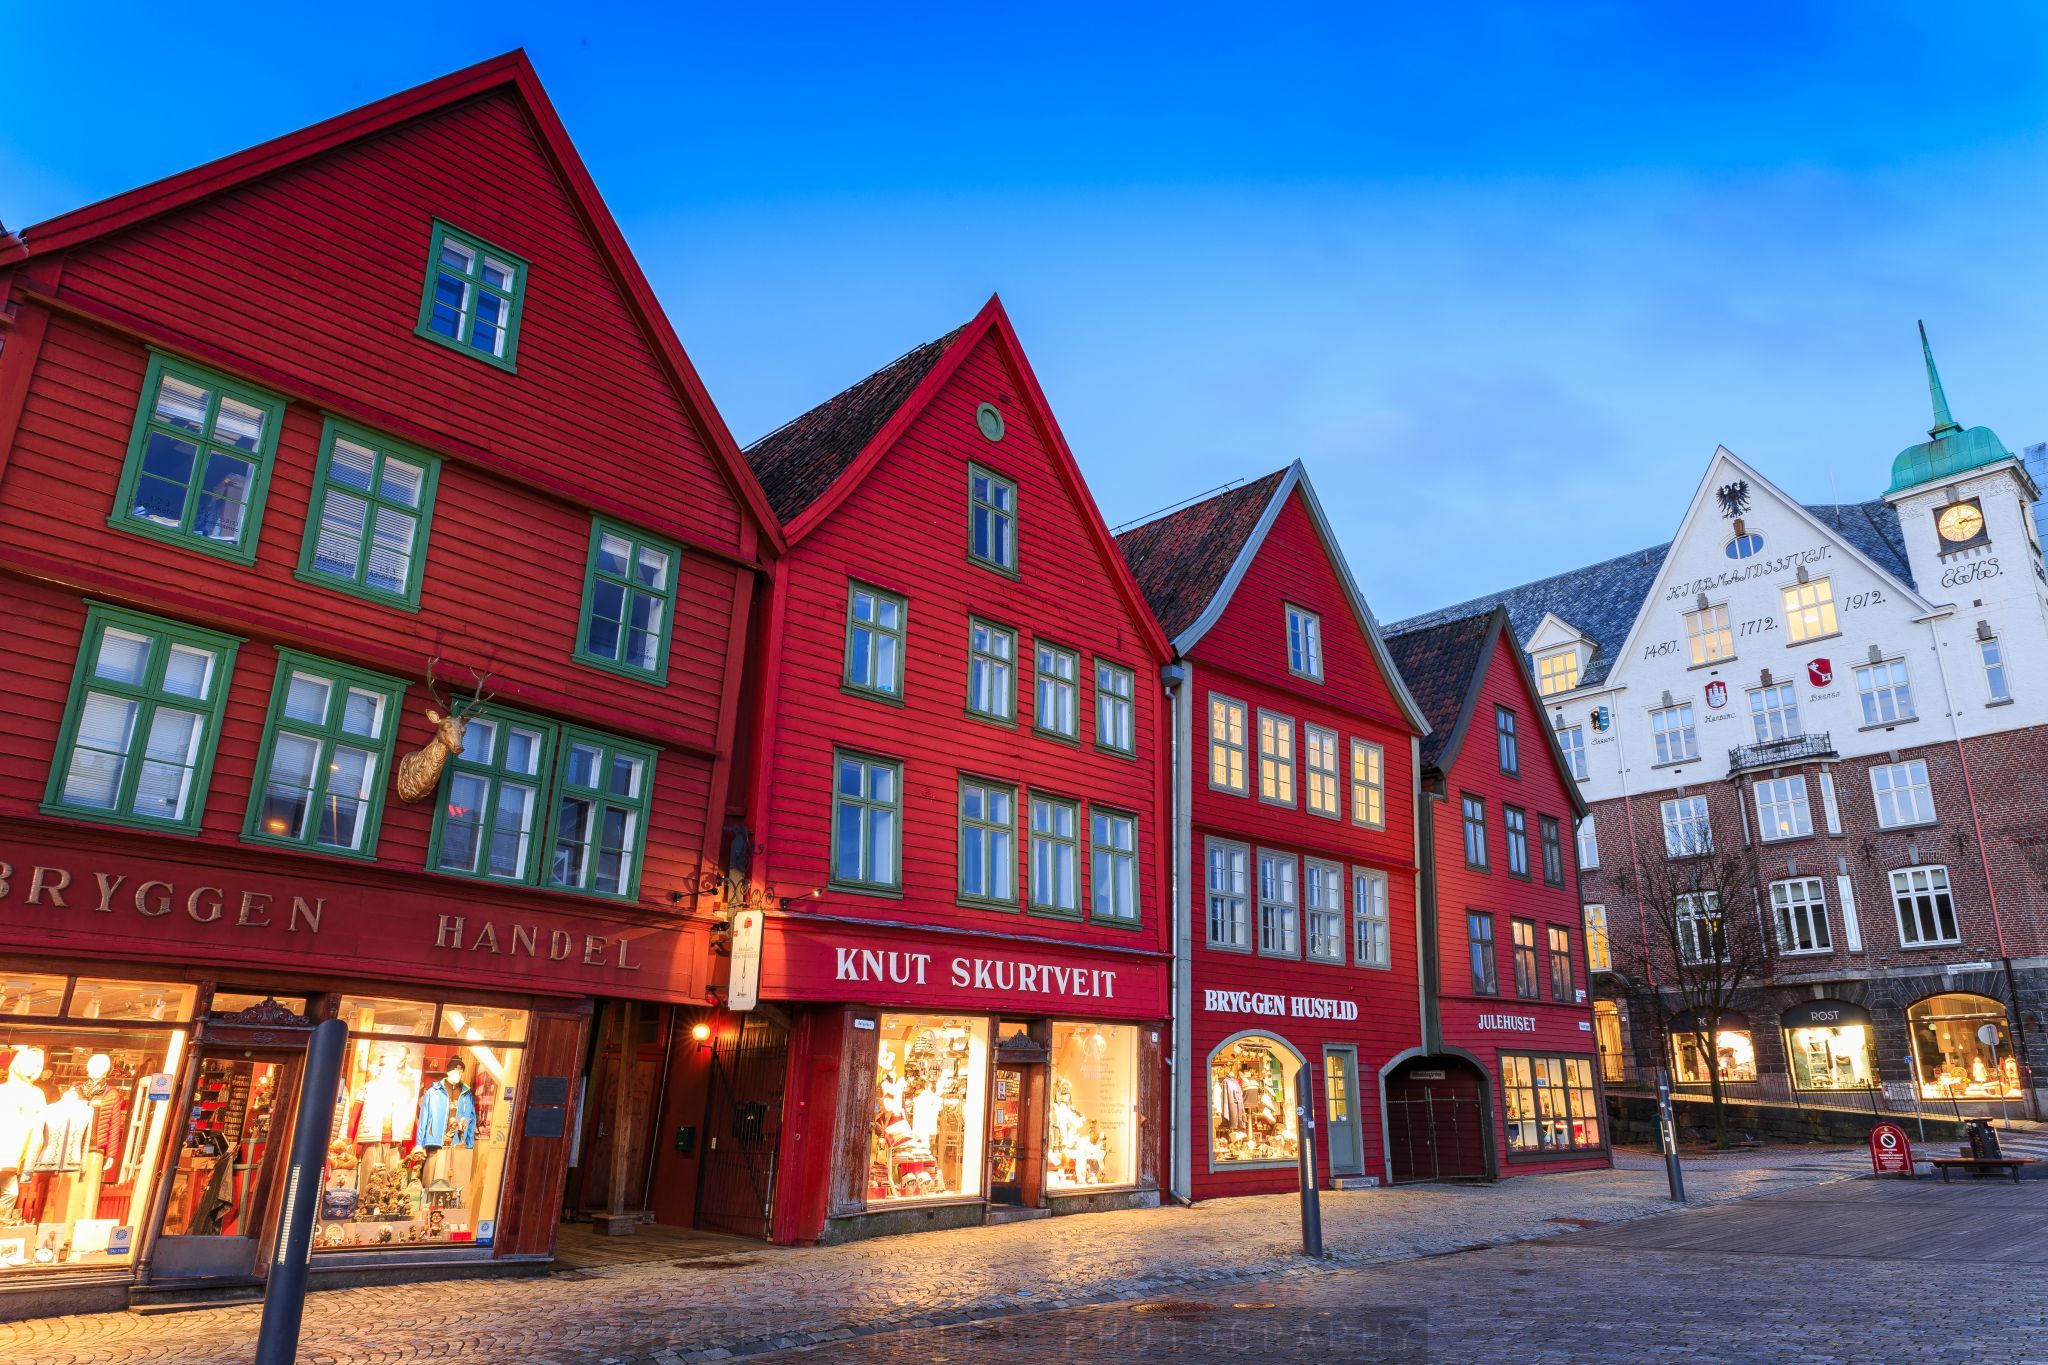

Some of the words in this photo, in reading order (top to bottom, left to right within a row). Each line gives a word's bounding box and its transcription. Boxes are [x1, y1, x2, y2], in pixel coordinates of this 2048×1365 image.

[1740, 617, 1778, 637] 1712.
[434, 914, 641, 970] HANDEL
[835, 947, 931, 985] KNUT
[951, 957, 1116, 998] SKURTVEIT
[1204, 989, 1286, 1016] BRYGGEN
[1290, 996, 1359, 1021] HUSFLID
[1811, 1010, 1839, 1021] ROST
[1478, 1014, 1536, 1032] JULEHUSET
